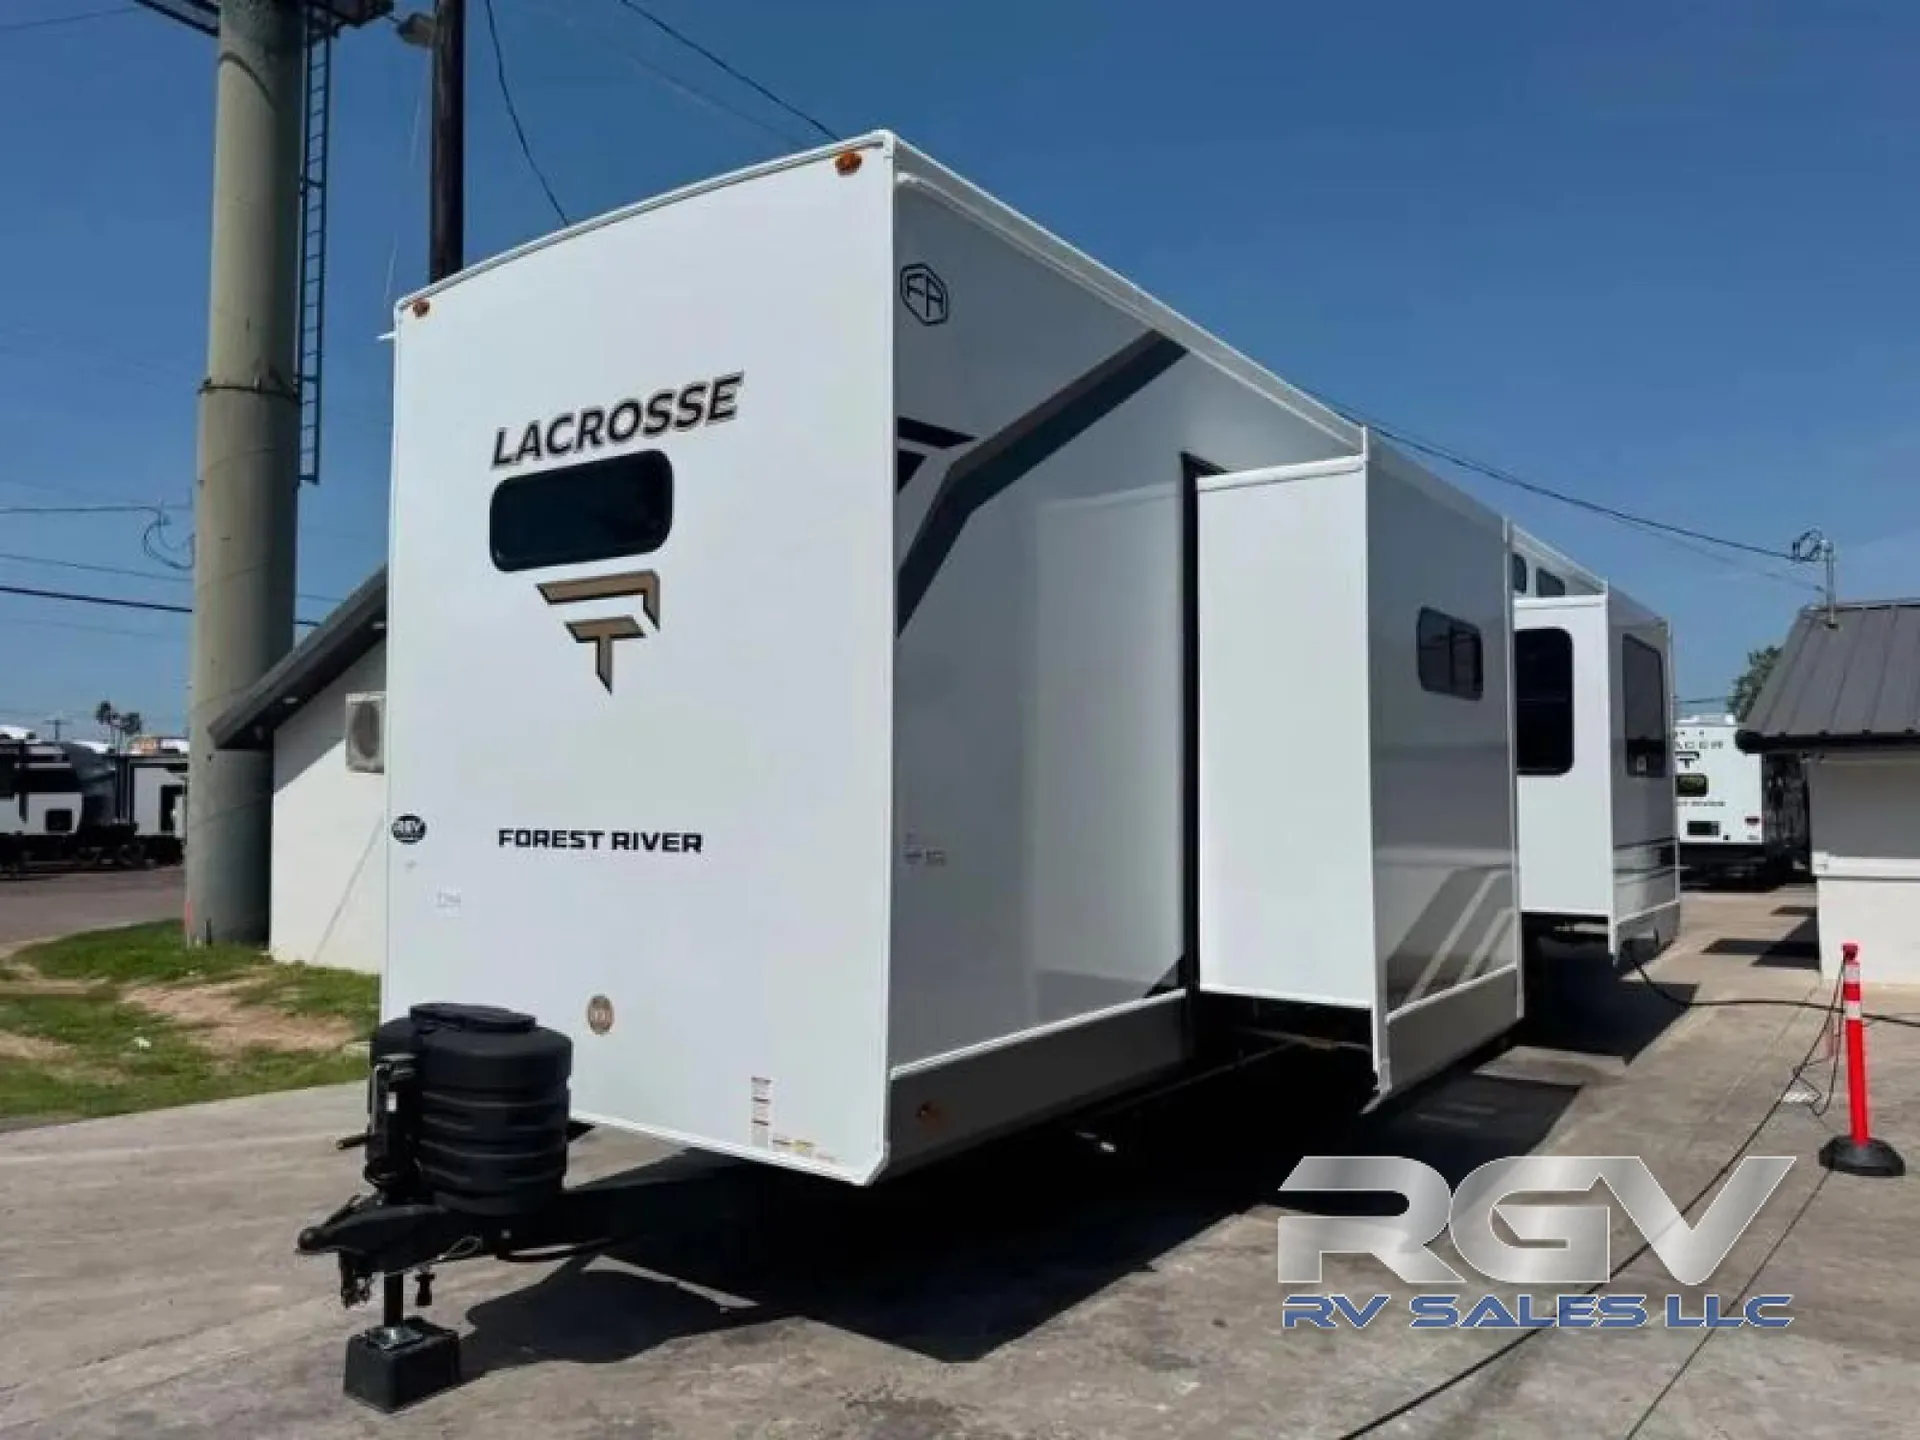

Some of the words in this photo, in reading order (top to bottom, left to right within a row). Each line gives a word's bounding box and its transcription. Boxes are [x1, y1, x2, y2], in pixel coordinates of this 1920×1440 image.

[491, 370, 745, 469] LACROSSE
[499, 829, 605, 850] FOREST
[611, 831, 703, 853] RIVER
